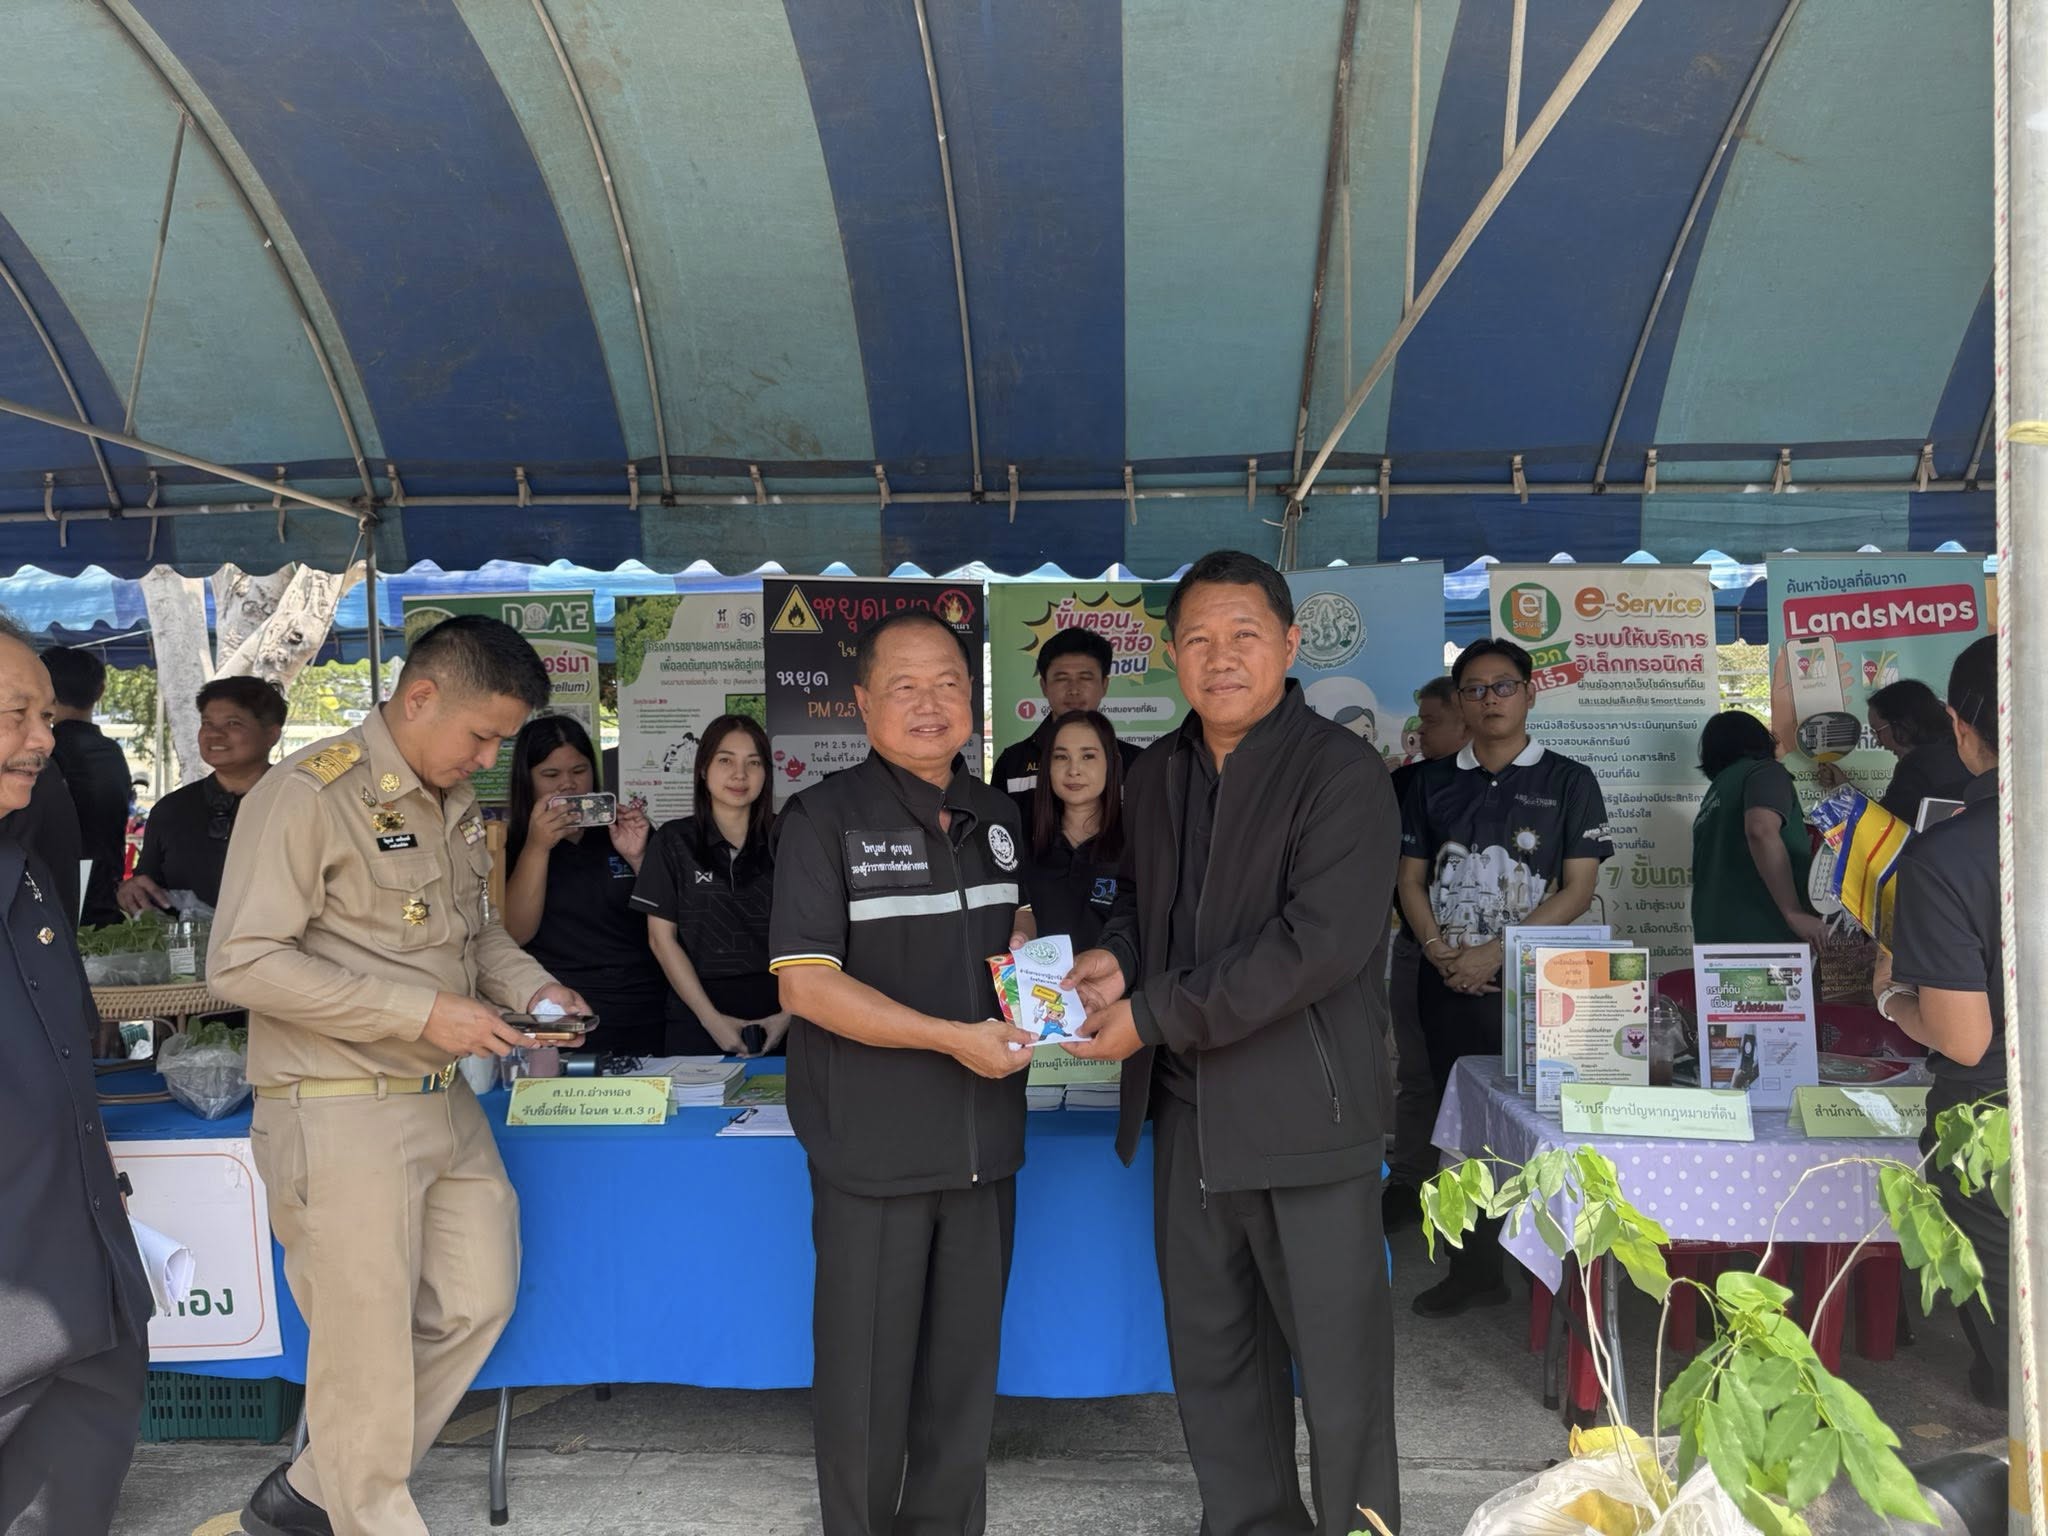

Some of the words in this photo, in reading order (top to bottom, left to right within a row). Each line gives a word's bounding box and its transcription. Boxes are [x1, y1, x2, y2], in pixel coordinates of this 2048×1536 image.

[1786, 570, 1907, 594] ค้นหาข้อมูลที่ดินจาก
[1574, 586, 1704, 618] e-Service
[503, 602, 589, 633] DOAE
[1055, 600, 1131, 629] ขั้นตอน
[1788, 600, 1975, 636] LandsMaps
[1106, 623, 1154, 653] ัดซื้อ
[1574, 627, 1708, 648] ระบบให้บริการ
[1575, 652, 1704, 674] อิเล็กทรอนิกส์
[776, 669, 829, 695] หยุด
[1577, 677, 1705, 691] ผ่านช่องทางเว็บไซต์กรมที่ดิน
[807, 701, 831, 719] PM
[835, 701, 857, 718] 2.5
[814, 741, 829, 749] PM
[832, 741, 847, 749] 2.5
[1605, 866, 1622, 889] 7
[1635, 899, 1685, 913] เข้าสู่ระบบ
[1626, 924, 1637, 934] 2.
[1705, 980, 1741, 995] กรมที่ดิน
[551, 1086, 632, 1098] ส.ป.ก.อ่างทอง
[522, 1103, 577, 1116] รับซื้อที่ดิน
[579, 1103, 609, 1116] โฉนด
[1574, 1101, 1737, 1122] รับปรึกษาปัญหากฎหมายที่ดิน
